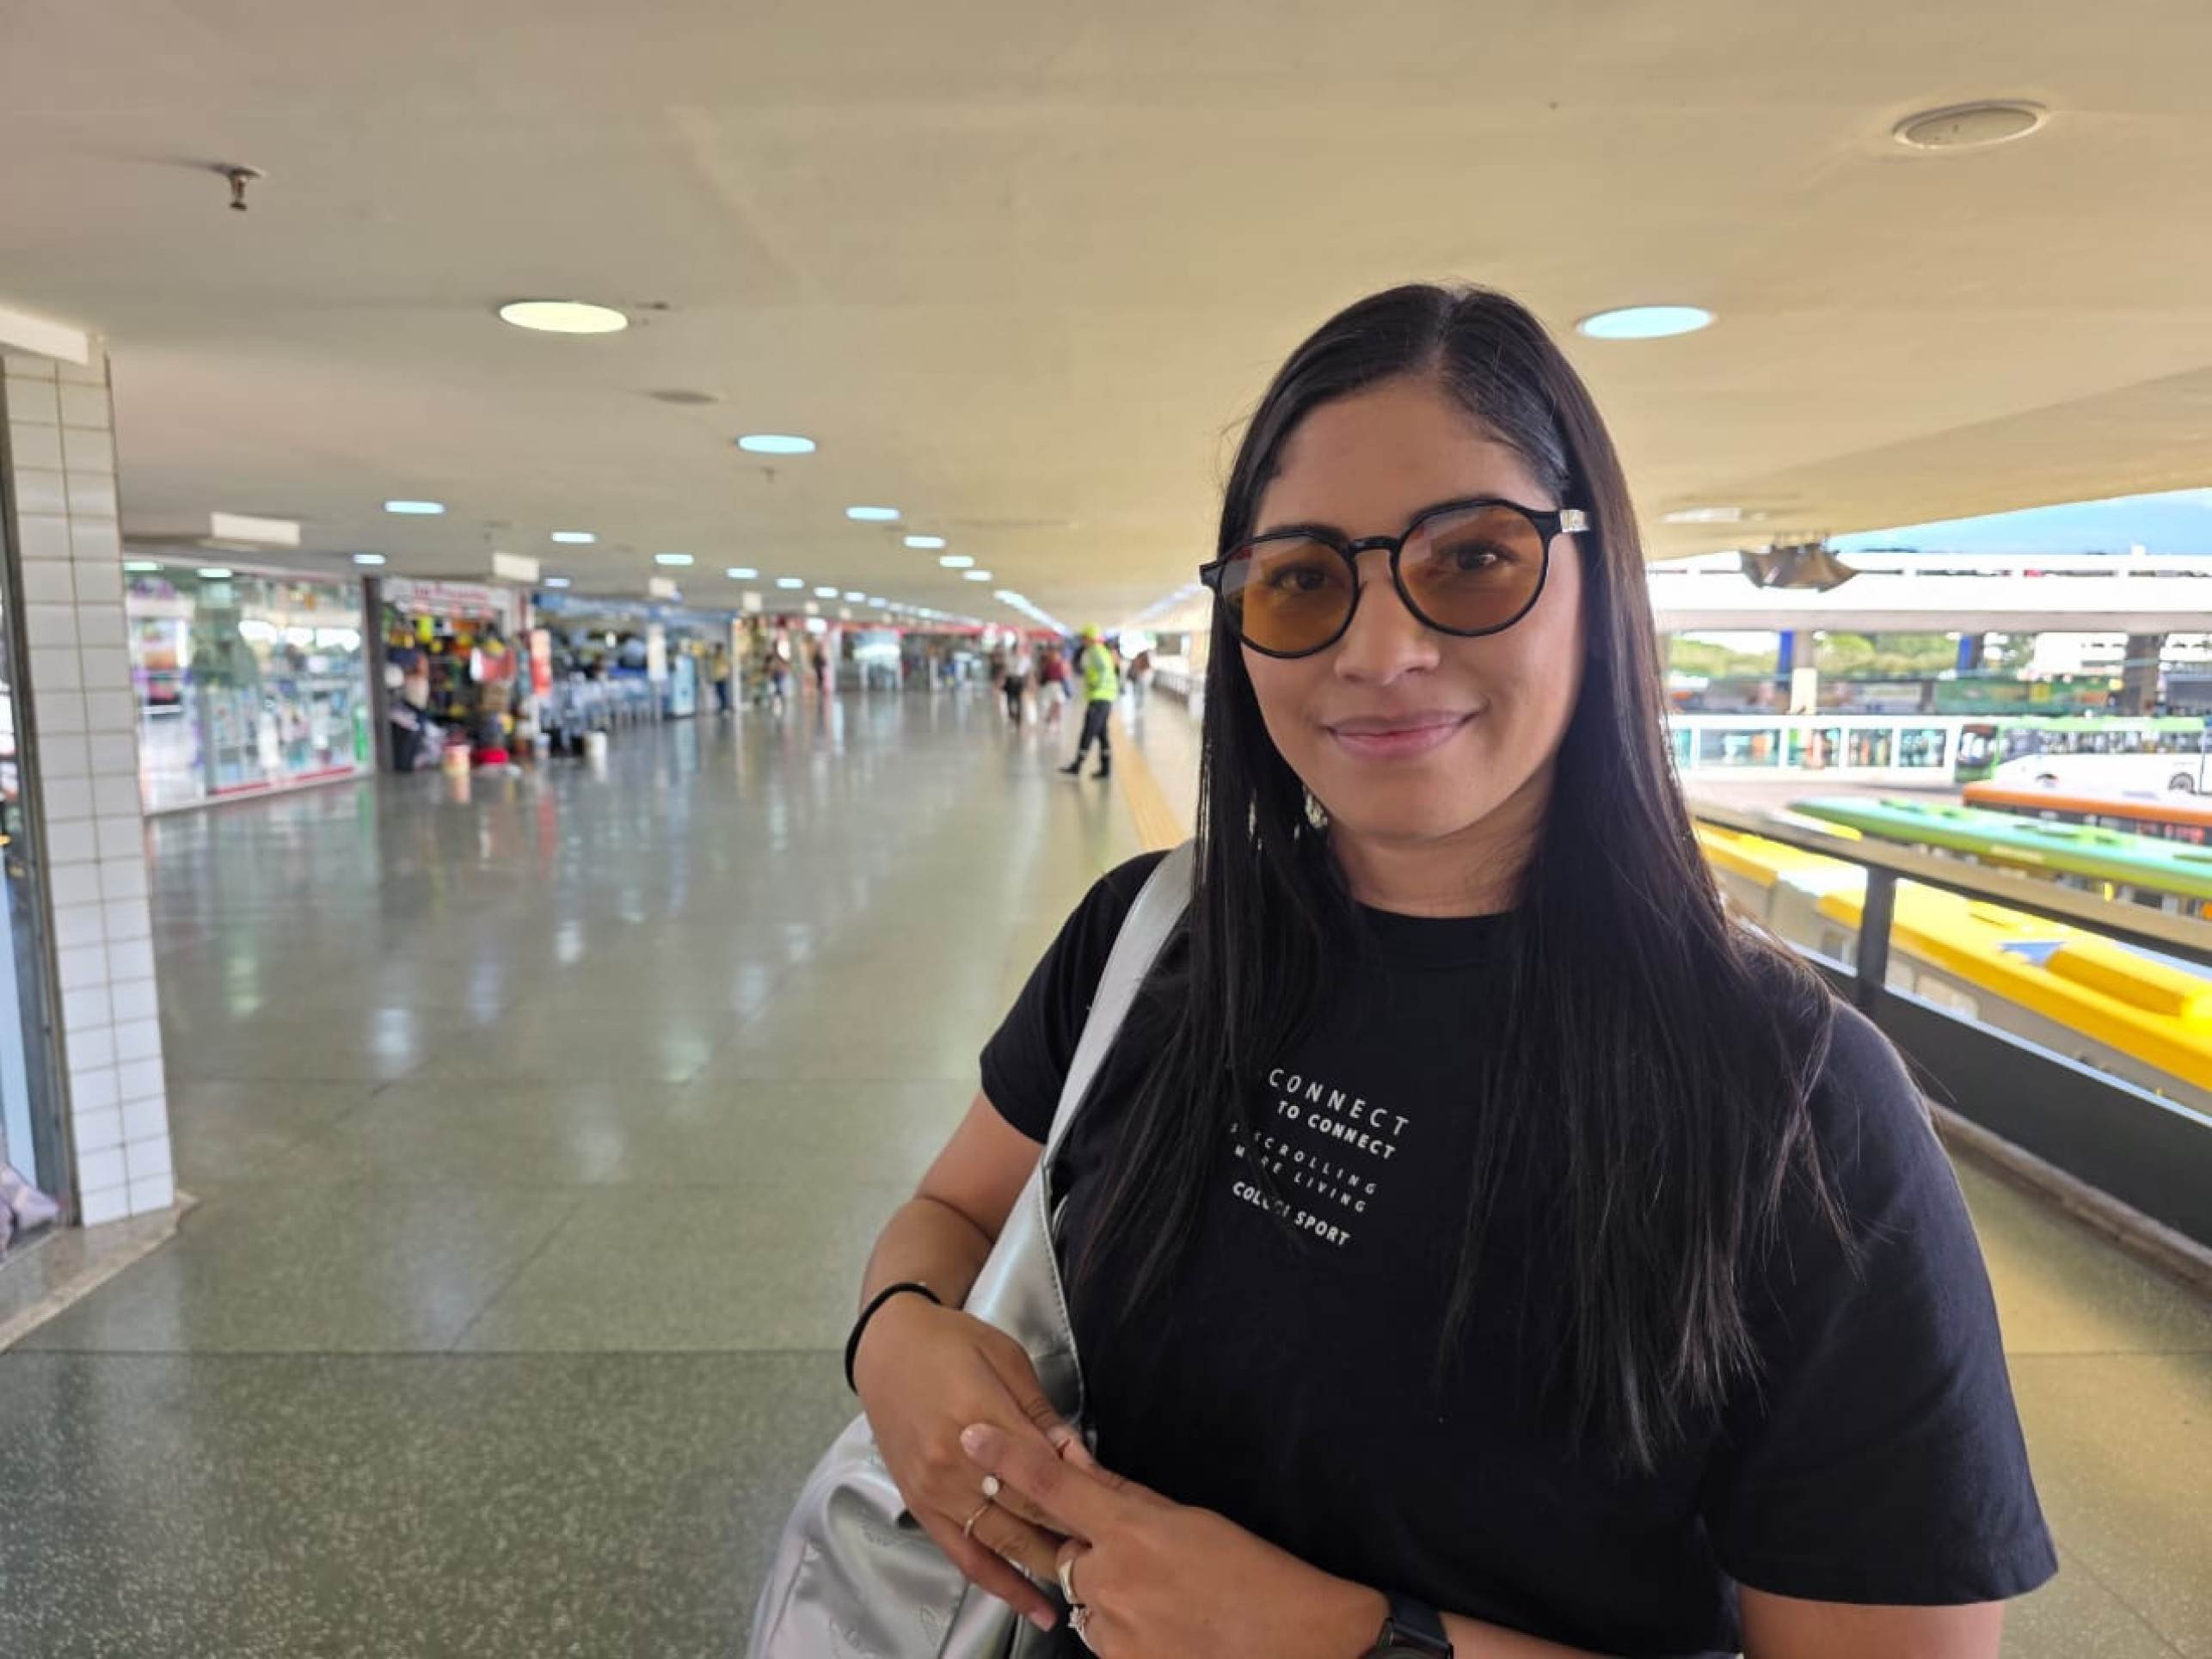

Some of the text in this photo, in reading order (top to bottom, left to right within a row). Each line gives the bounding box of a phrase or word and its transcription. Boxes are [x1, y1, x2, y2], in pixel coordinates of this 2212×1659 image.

[1269, 1068, 1409, 1136] CONNECT
[1277, 1100, 1397, 1159] TO CONNECT
[1234, 1145, 1367, 1213] MRE LIVING
[1294, 1210, 1351, 1246] SPORT
